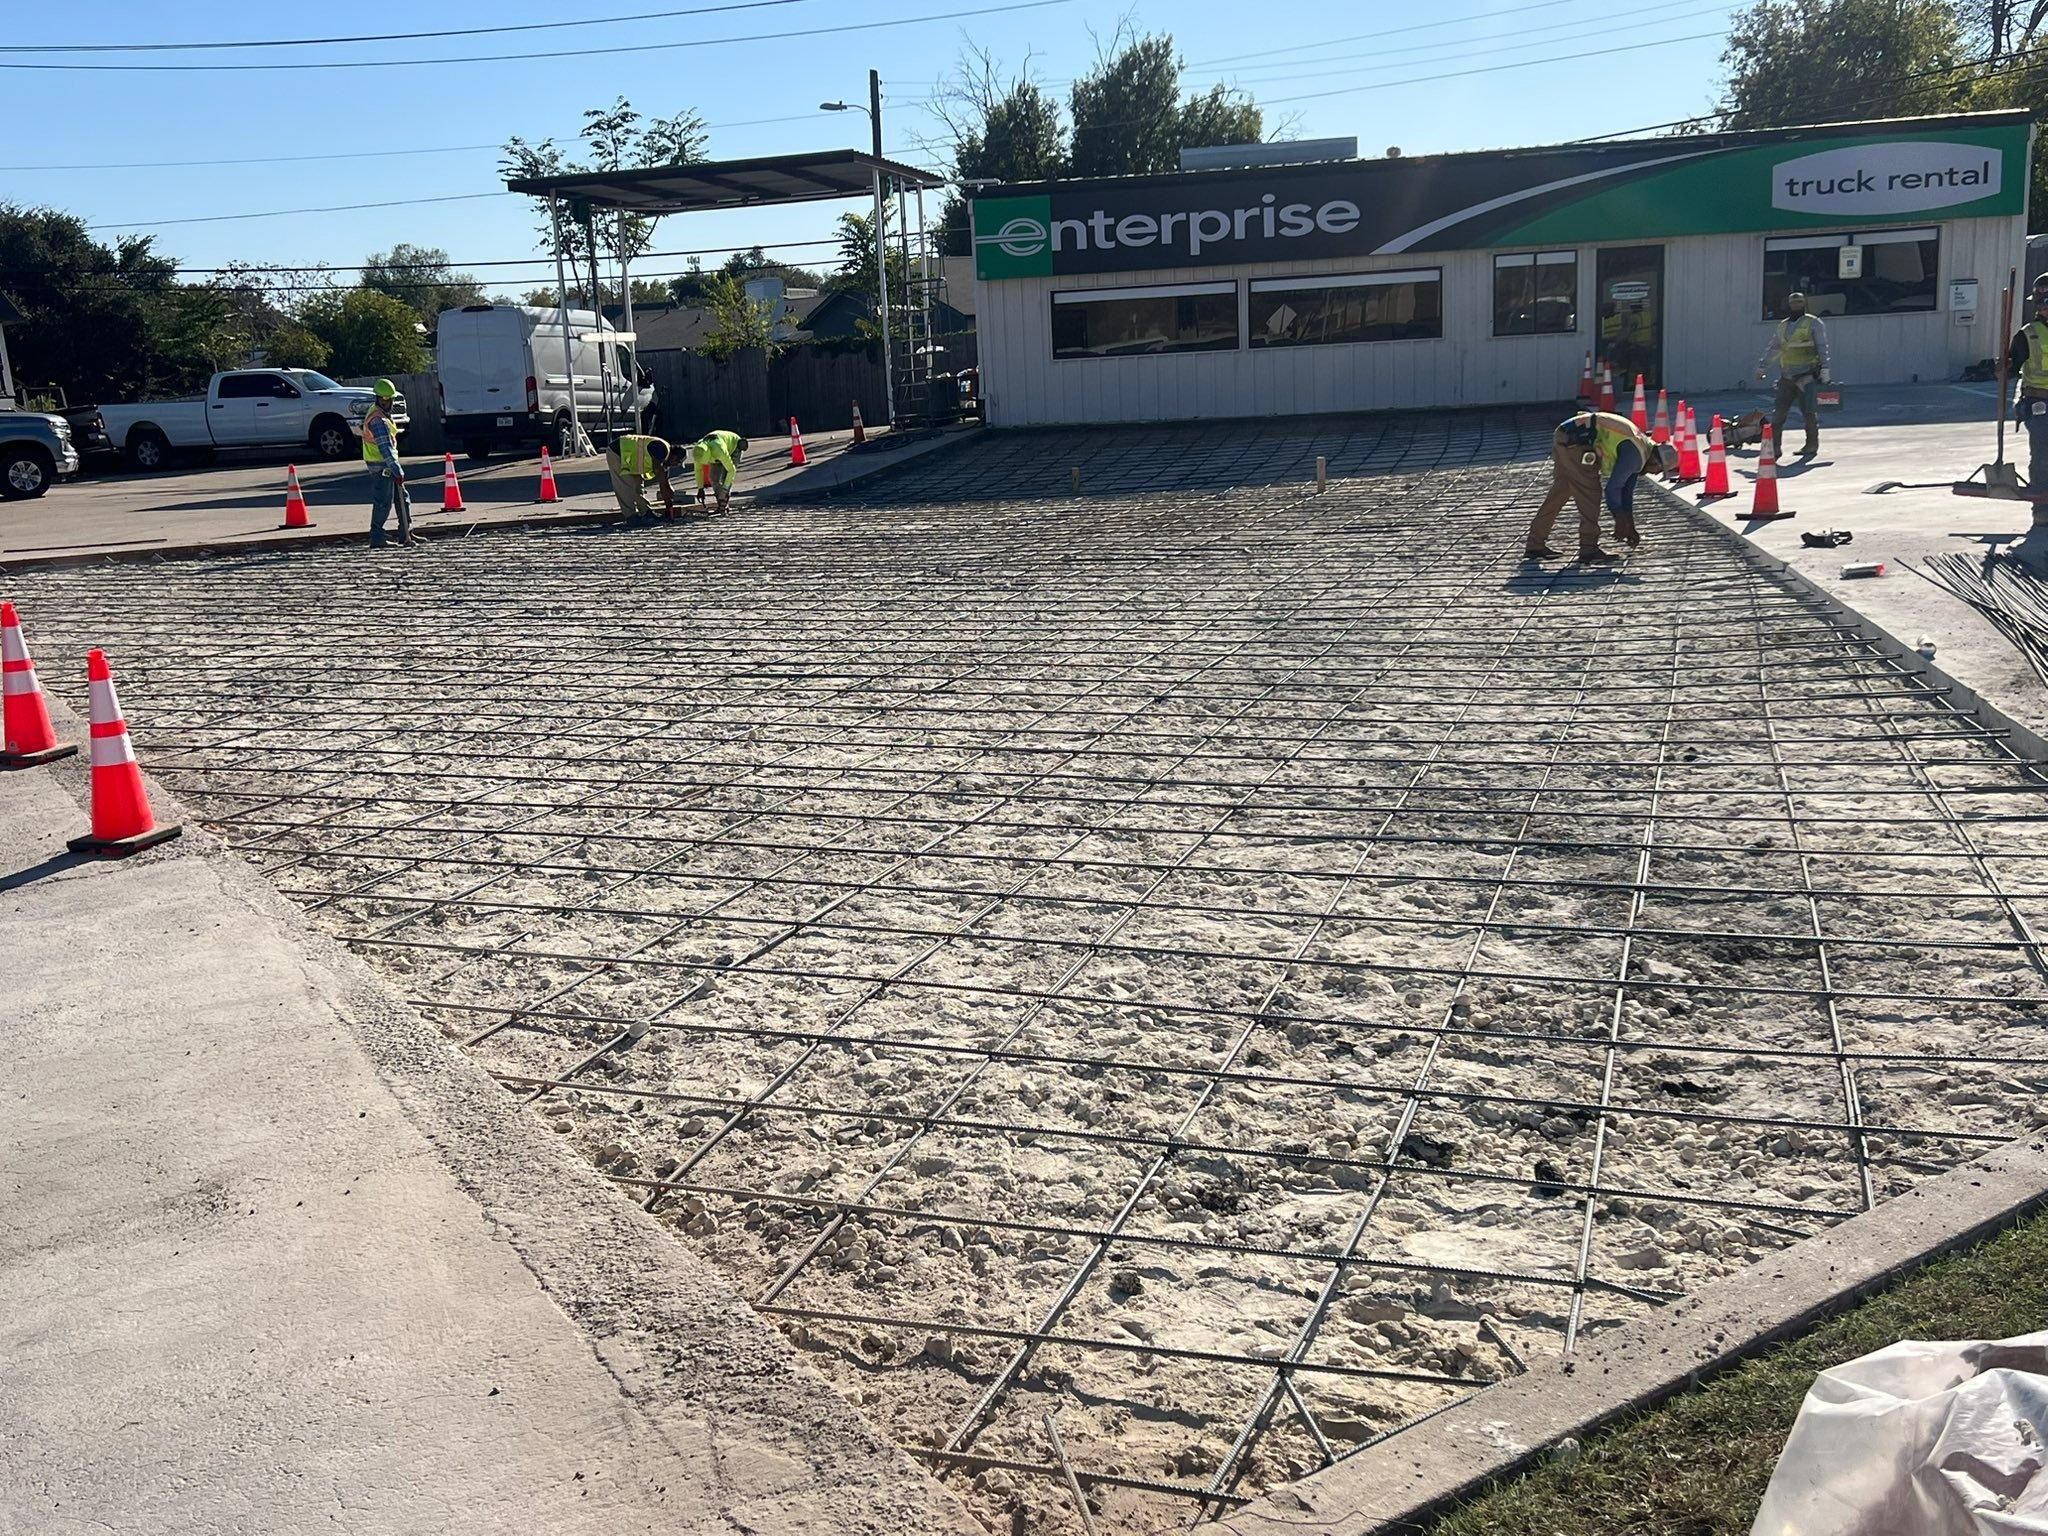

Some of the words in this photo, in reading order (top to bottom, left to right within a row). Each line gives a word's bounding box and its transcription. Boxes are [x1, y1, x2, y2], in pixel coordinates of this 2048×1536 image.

[1785, 169, 1876, 197] truck
[1888, 161, 1989, 191] rental
[998, 193, 1361, 256] enterprise
